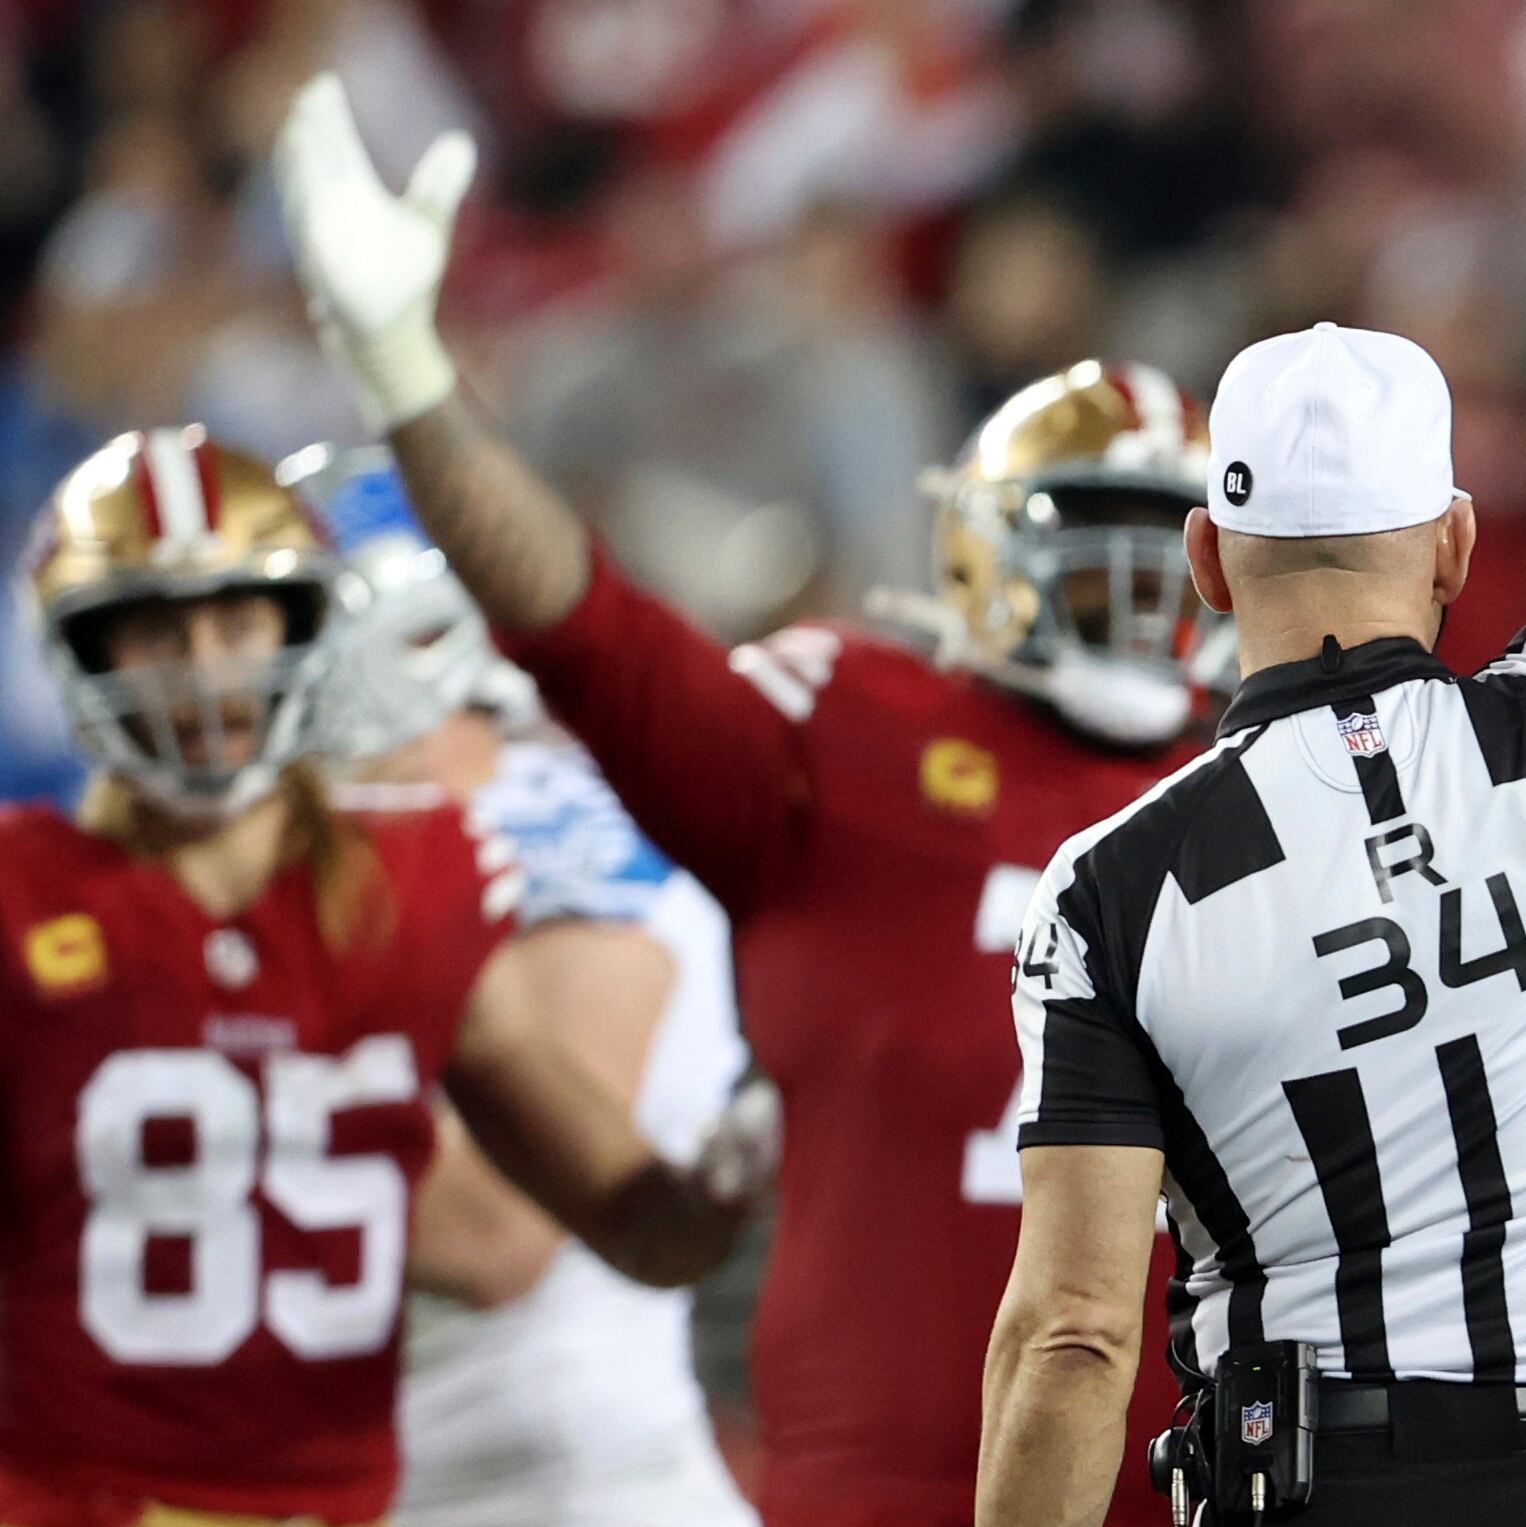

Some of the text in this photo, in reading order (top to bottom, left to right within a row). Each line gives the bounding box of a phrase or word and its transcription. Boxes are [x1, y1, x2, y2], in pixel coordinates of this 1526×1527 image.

[1226, 471, 1247, 494] BL
[1344, 730, 1383, 752] NFL
[1364, 822, 1447, 903] R
[76, 1034, 418, 1366] 85
